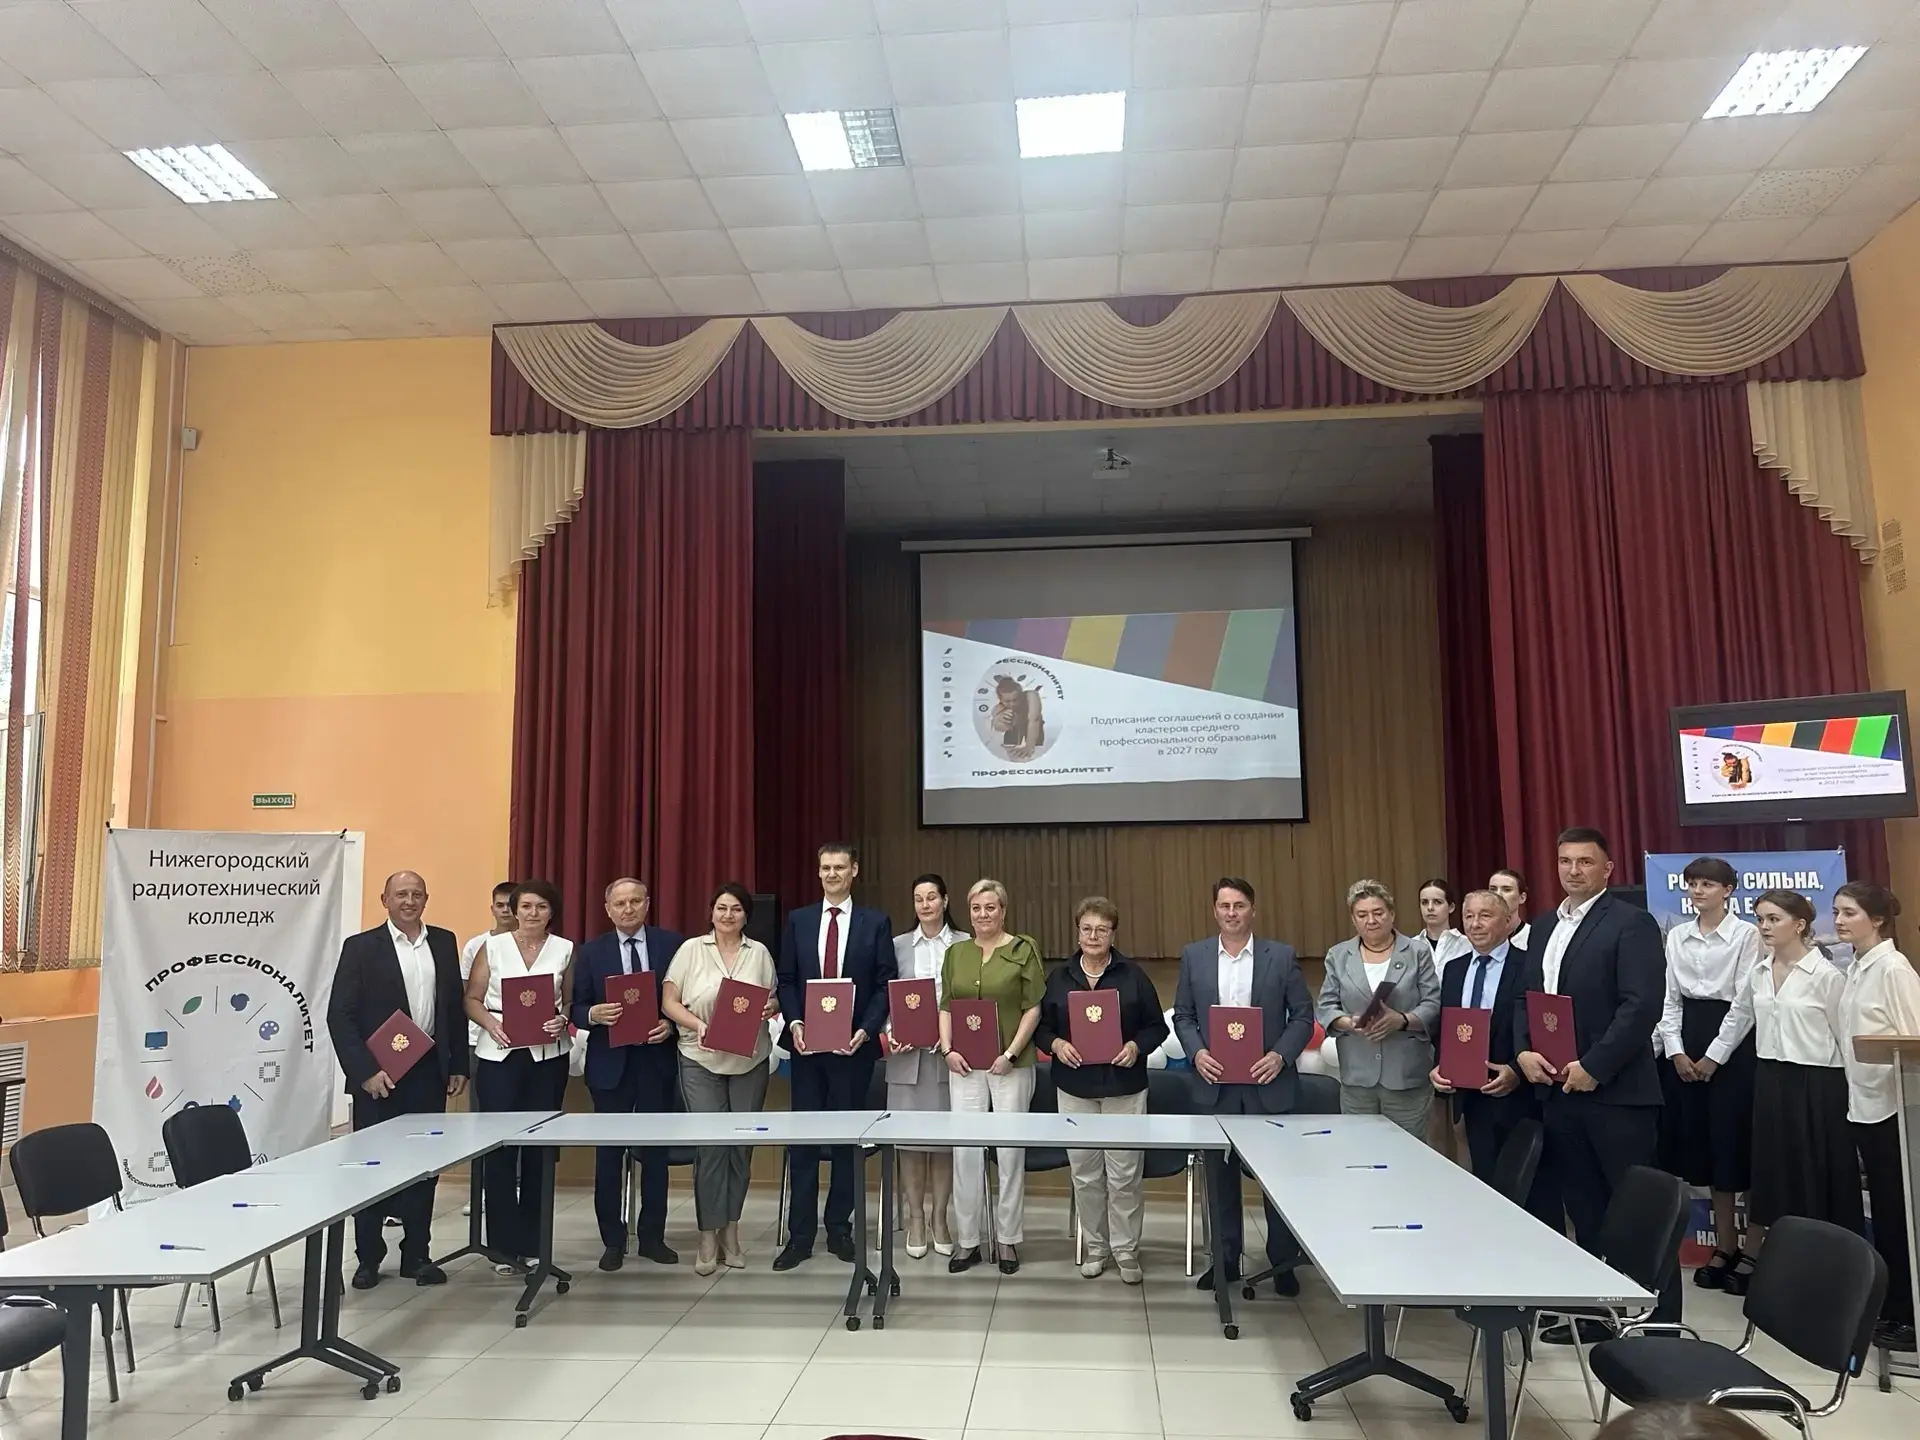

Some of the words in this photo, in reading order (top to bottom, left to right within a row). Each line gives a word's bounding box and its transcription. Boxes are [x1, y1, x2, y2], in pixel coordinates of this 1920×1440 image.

[1090, 716, 1156, 726] Подписание
[1158, 712, 1221, 723] соглашений
[1234, 712, 1285, 721] создании
[1135, 726, 1189, 735] кластеров
[1191, 724, 1241, 734] среднего
[1099, 736, 1205, 747] профессионального
[1207, 733, 1277, 743] образования
[1167, 746, 1192, 755] 2027
[1195, 746, 1218, 755] году
[971, 766, 1114, 777] ПРОФЕССИОНАЛИТЕТ
[149, 849, 310, 872] Нижегородский
[1743, 871, 1824, 890] СИЛЬНА,
[132, 879, 321, 901] радиотехнический
[188, 910, 275, 926] колледж
[145, 953, 314, 1053] ПРОФЕССИОНАЛИТЕТ
